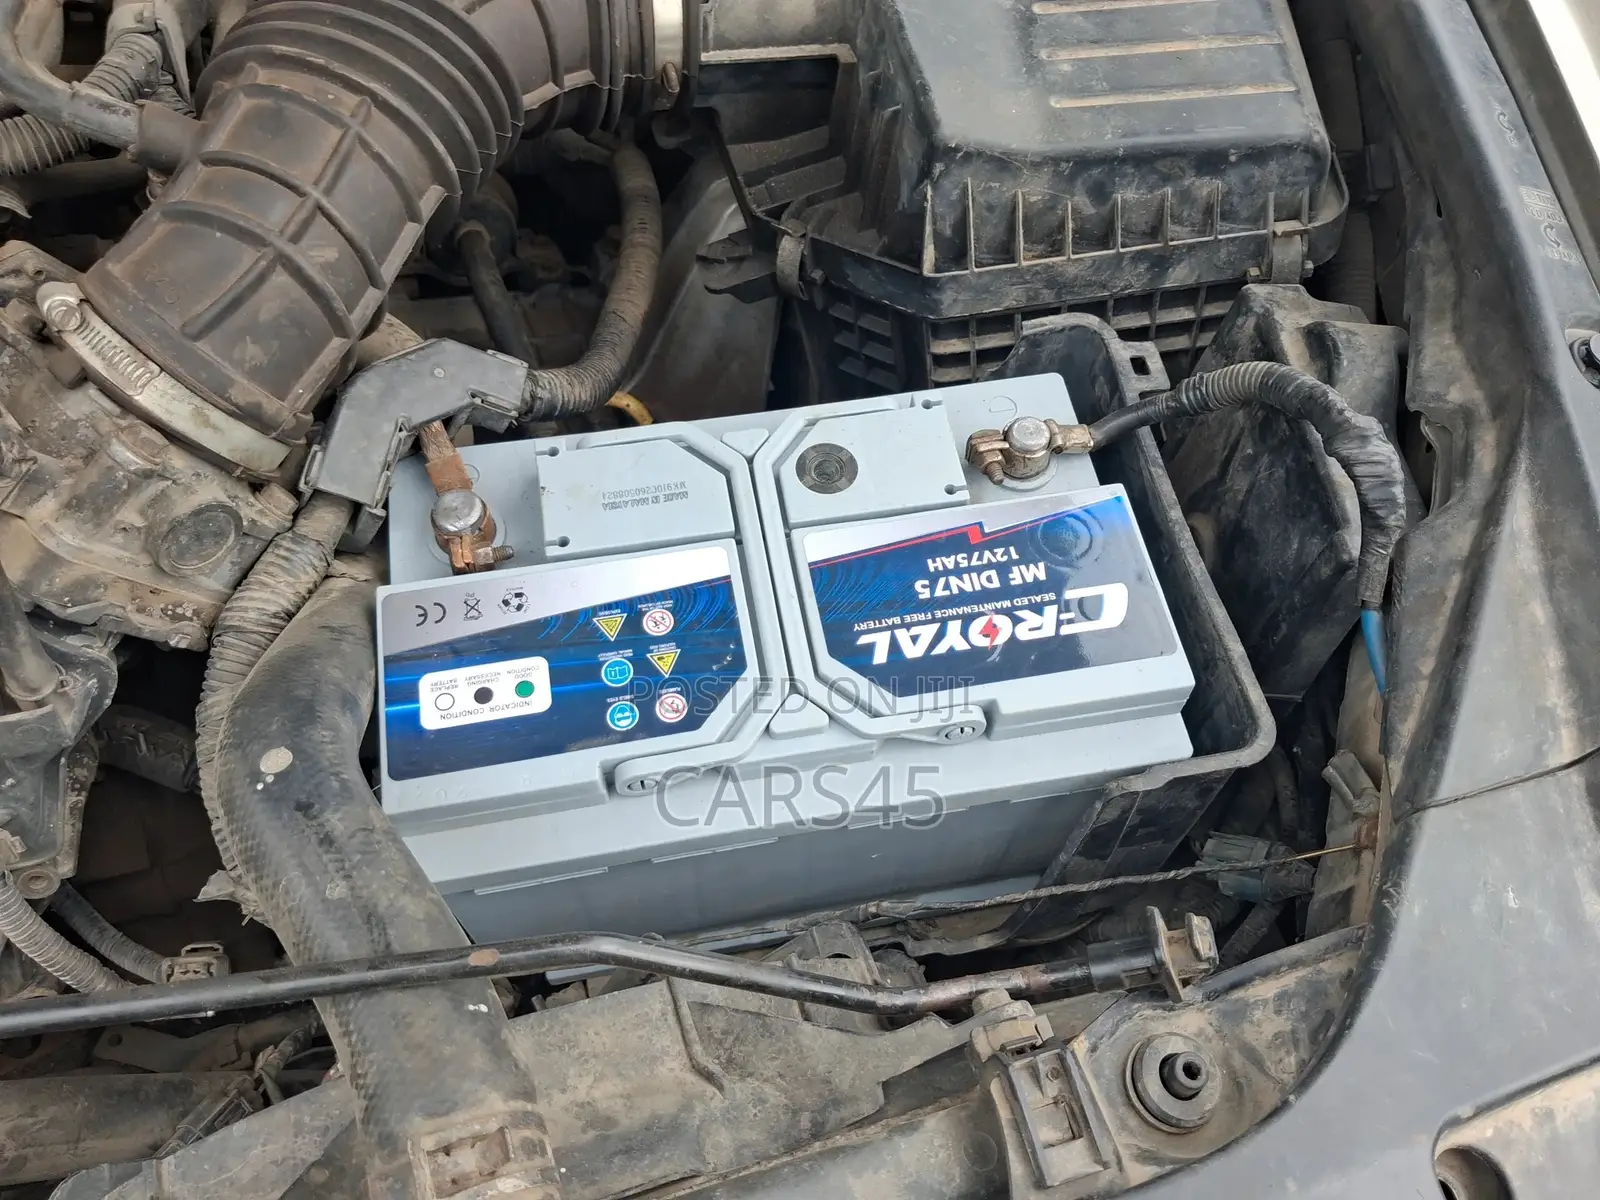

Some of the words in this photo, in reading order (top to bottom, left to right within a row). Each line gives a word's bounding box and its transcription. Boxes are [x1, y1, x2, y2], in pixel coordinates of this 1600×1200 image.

[651, 496, 660, 504] IN
[662, 491, 688, 502] MADE
[602, 497, 649, 510] MALAYSIA
[927, 545, 1020, 572] 12V75AH
[1009, 562, 1046, 586] MF
[914, 569, 1000, 599] DIN75
[1014, 592, 1056, 607] SEALED
[415, 602, 447, 627] CE
[934, 599, 1011, 618] MAINTENANCE
[853, 615, 901, 632] BATTERY
[904, 611, 932, 623] FREE
[507, 665, 540, 674] CONDITION
[430, 678, 458, 687] BATTERY
[464, 671, 501, 682] NECESSARY
[467, 677, 500, 687] CHARGING
[430, 684, 459, 693] REPLACE
[489, 700, 532, 713] INDICATOR
[440, 707, 485, 720] CONDITION
